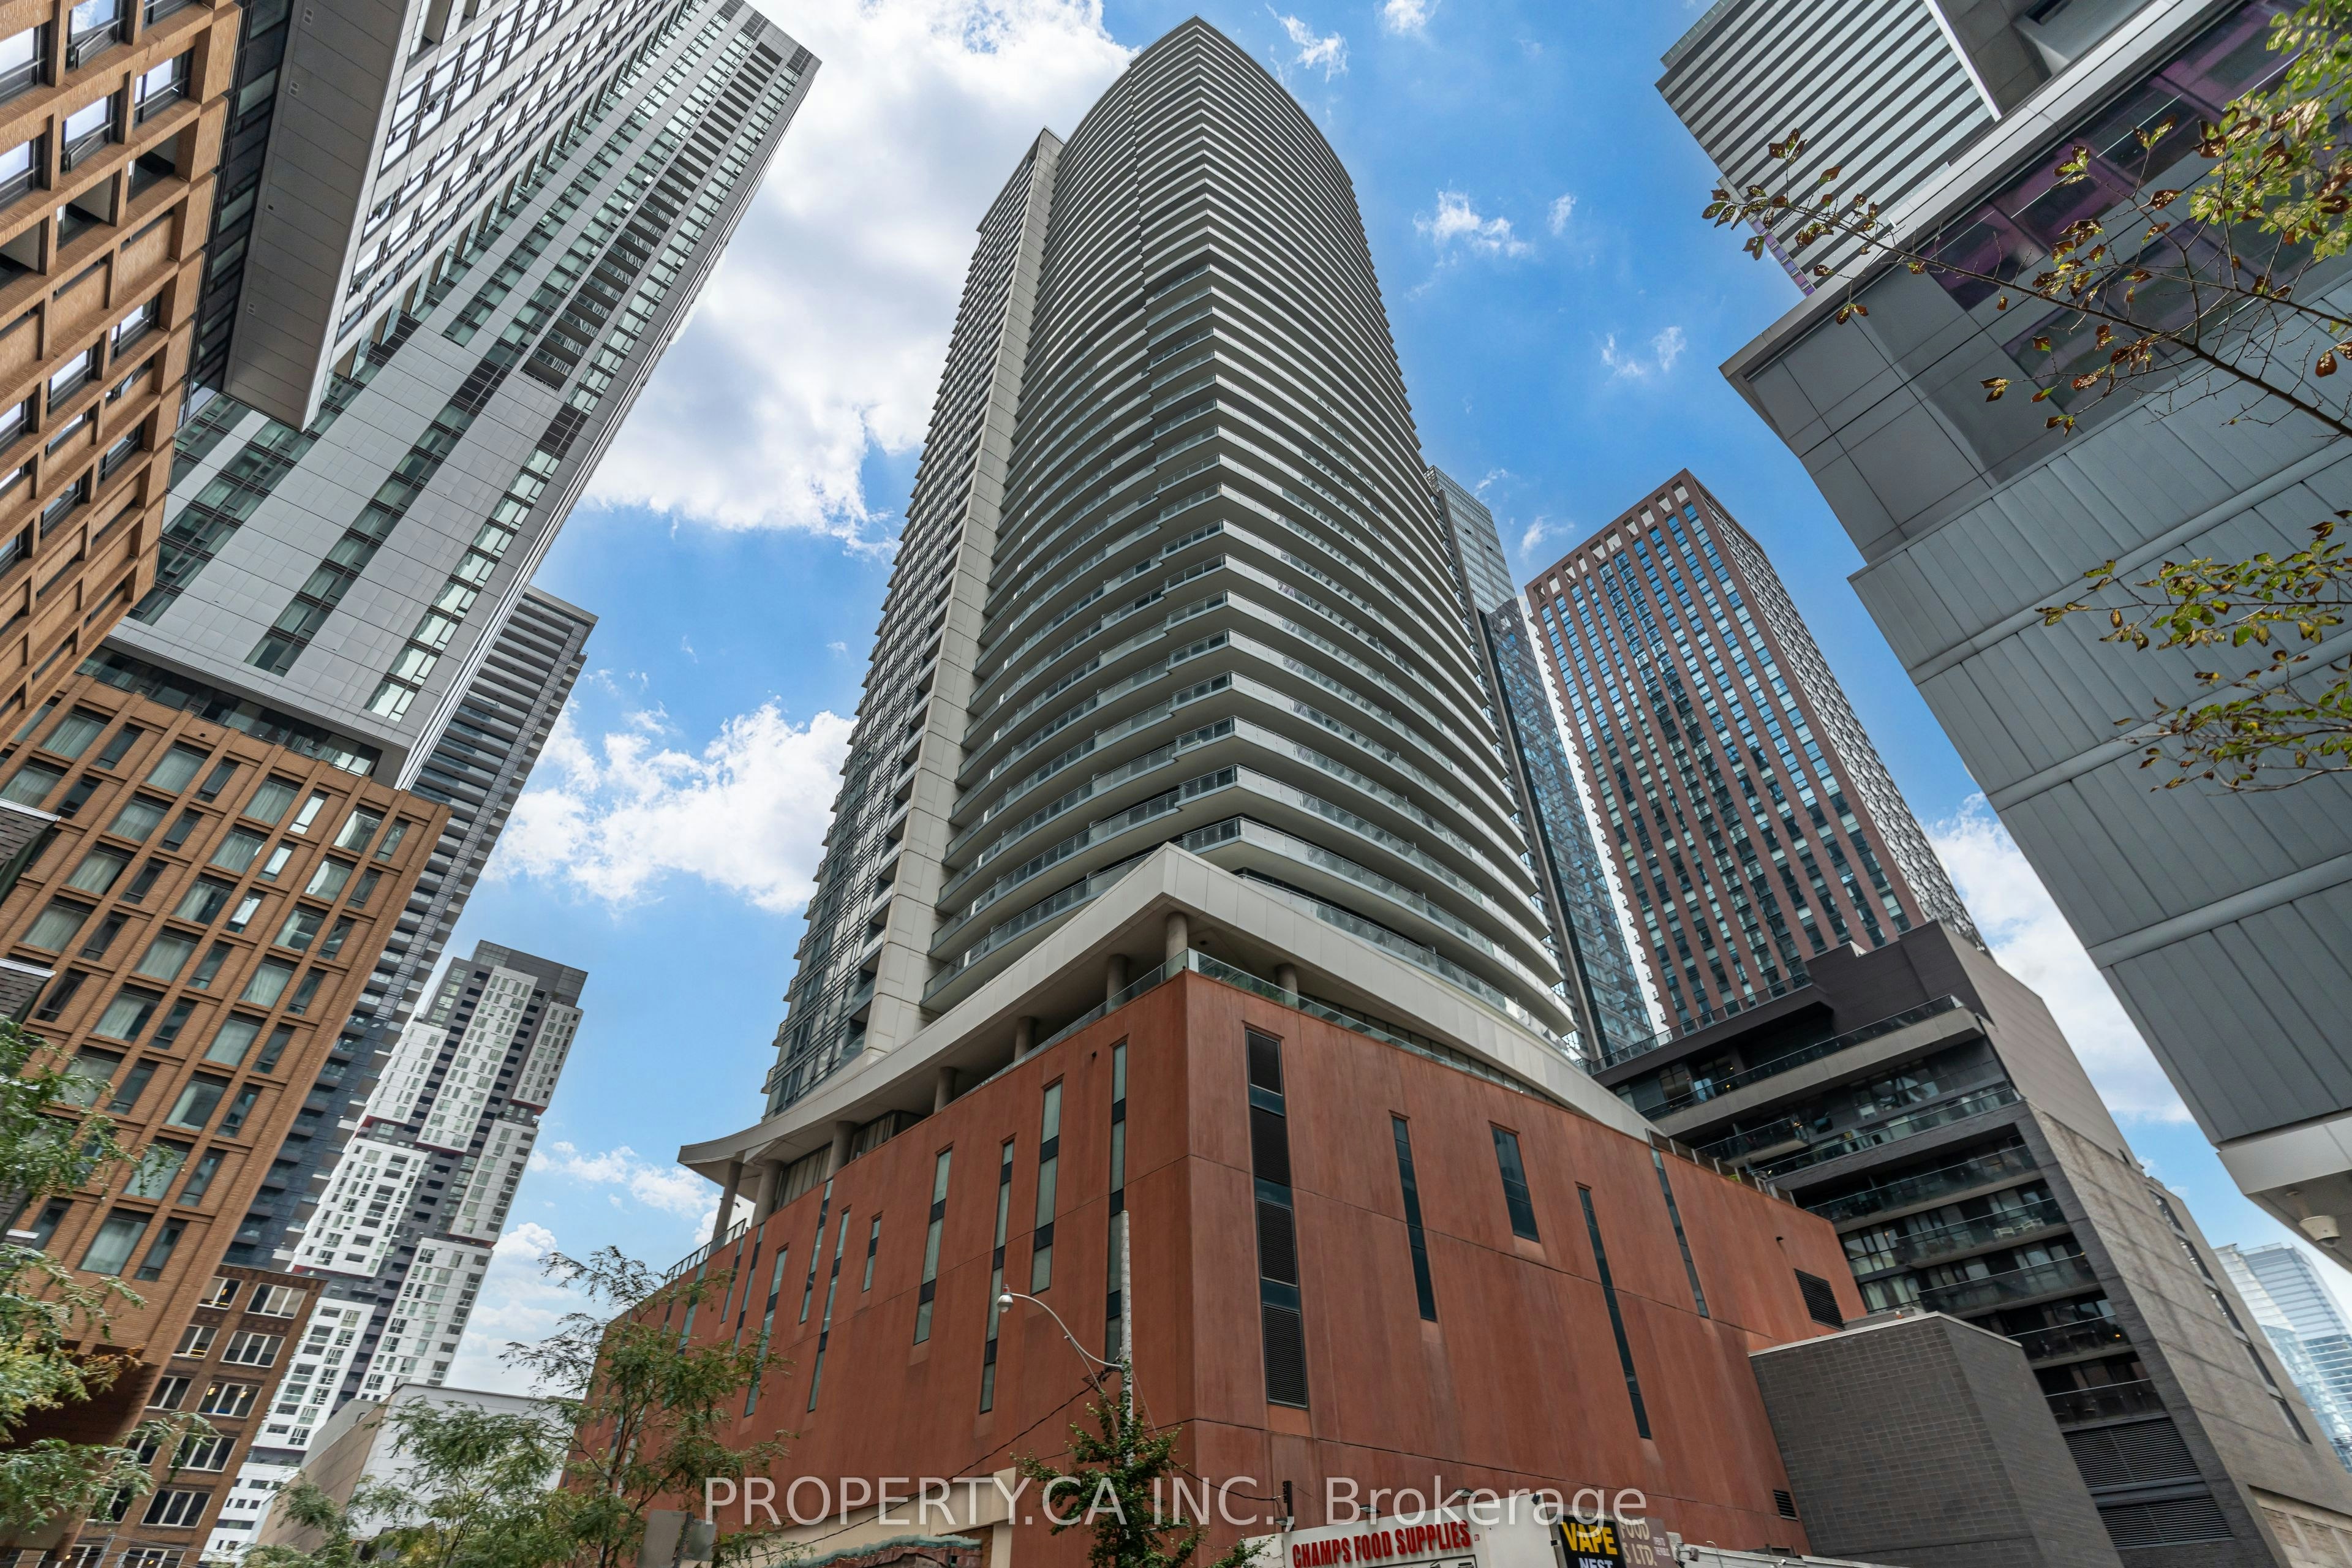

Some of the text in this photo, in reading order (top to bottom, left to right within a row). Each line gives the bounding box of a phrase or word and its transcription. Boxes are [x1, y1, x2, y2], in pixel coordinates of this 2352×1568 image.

[1292, 1520, 1471, 1568] CHAMPS FOOD SUPPLIES
[1561, 1521, 1618, 1556] VAPE
